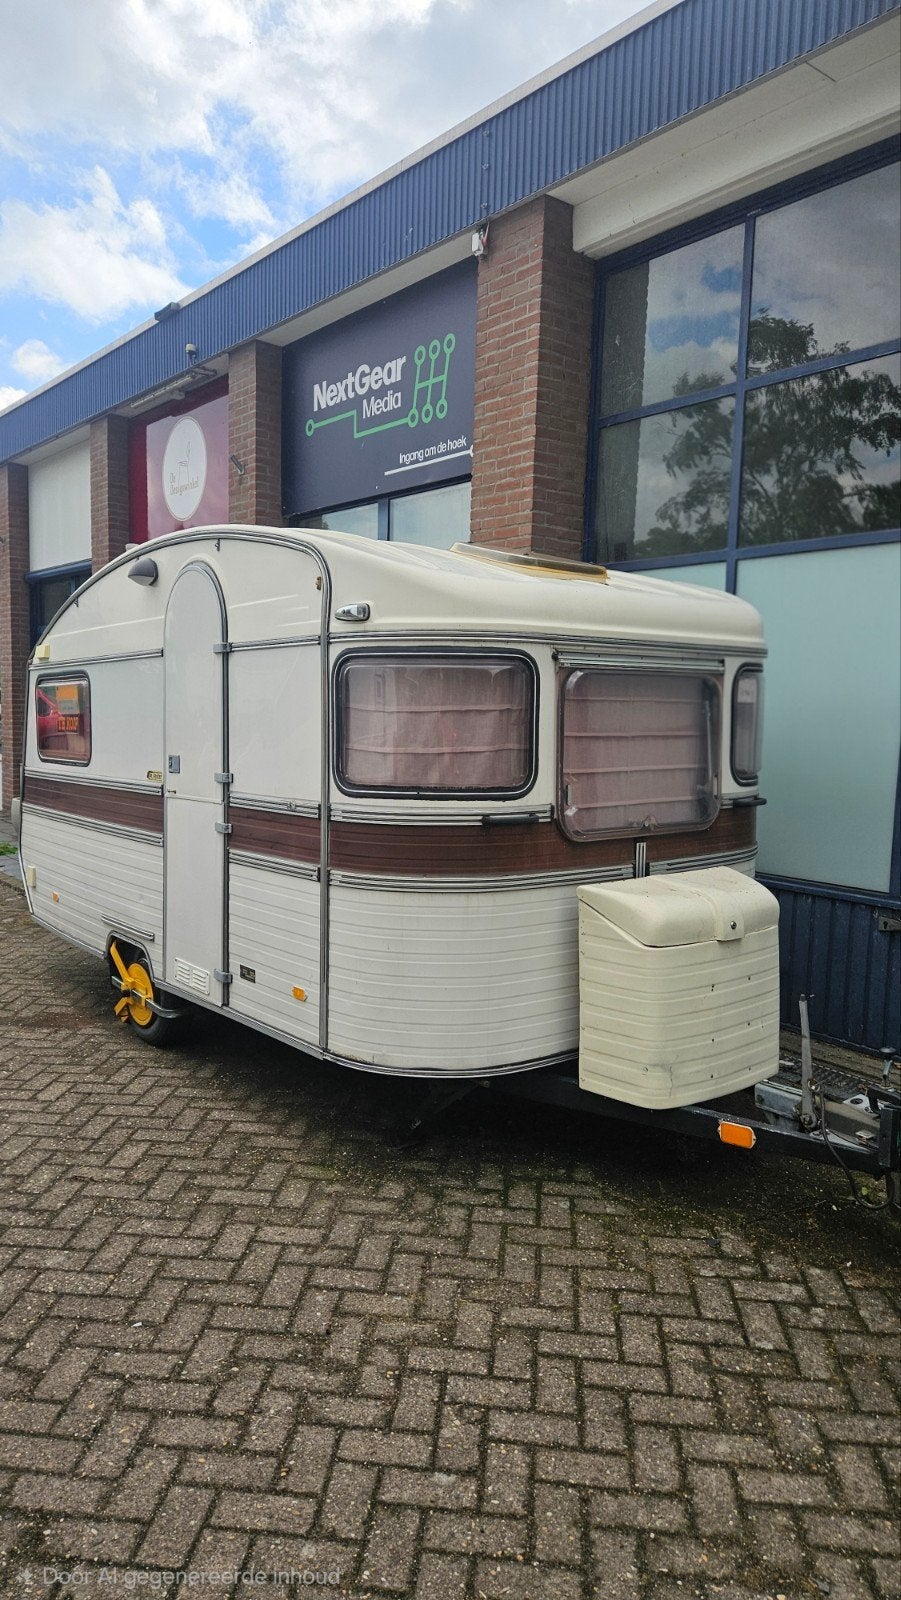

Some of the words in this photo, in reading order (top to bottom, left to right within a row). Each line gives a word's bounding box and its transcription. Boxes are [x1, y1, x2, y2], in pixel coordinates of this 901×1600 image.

[313, 356, 406, 412] NextGear
[362, 390, 402, 419] Media
[399, 450, 424, 464] Ingang
[425, 446, 437, 458] om
[436, 442, 447, 454] de
[447, 435, 467, 451] hoek
